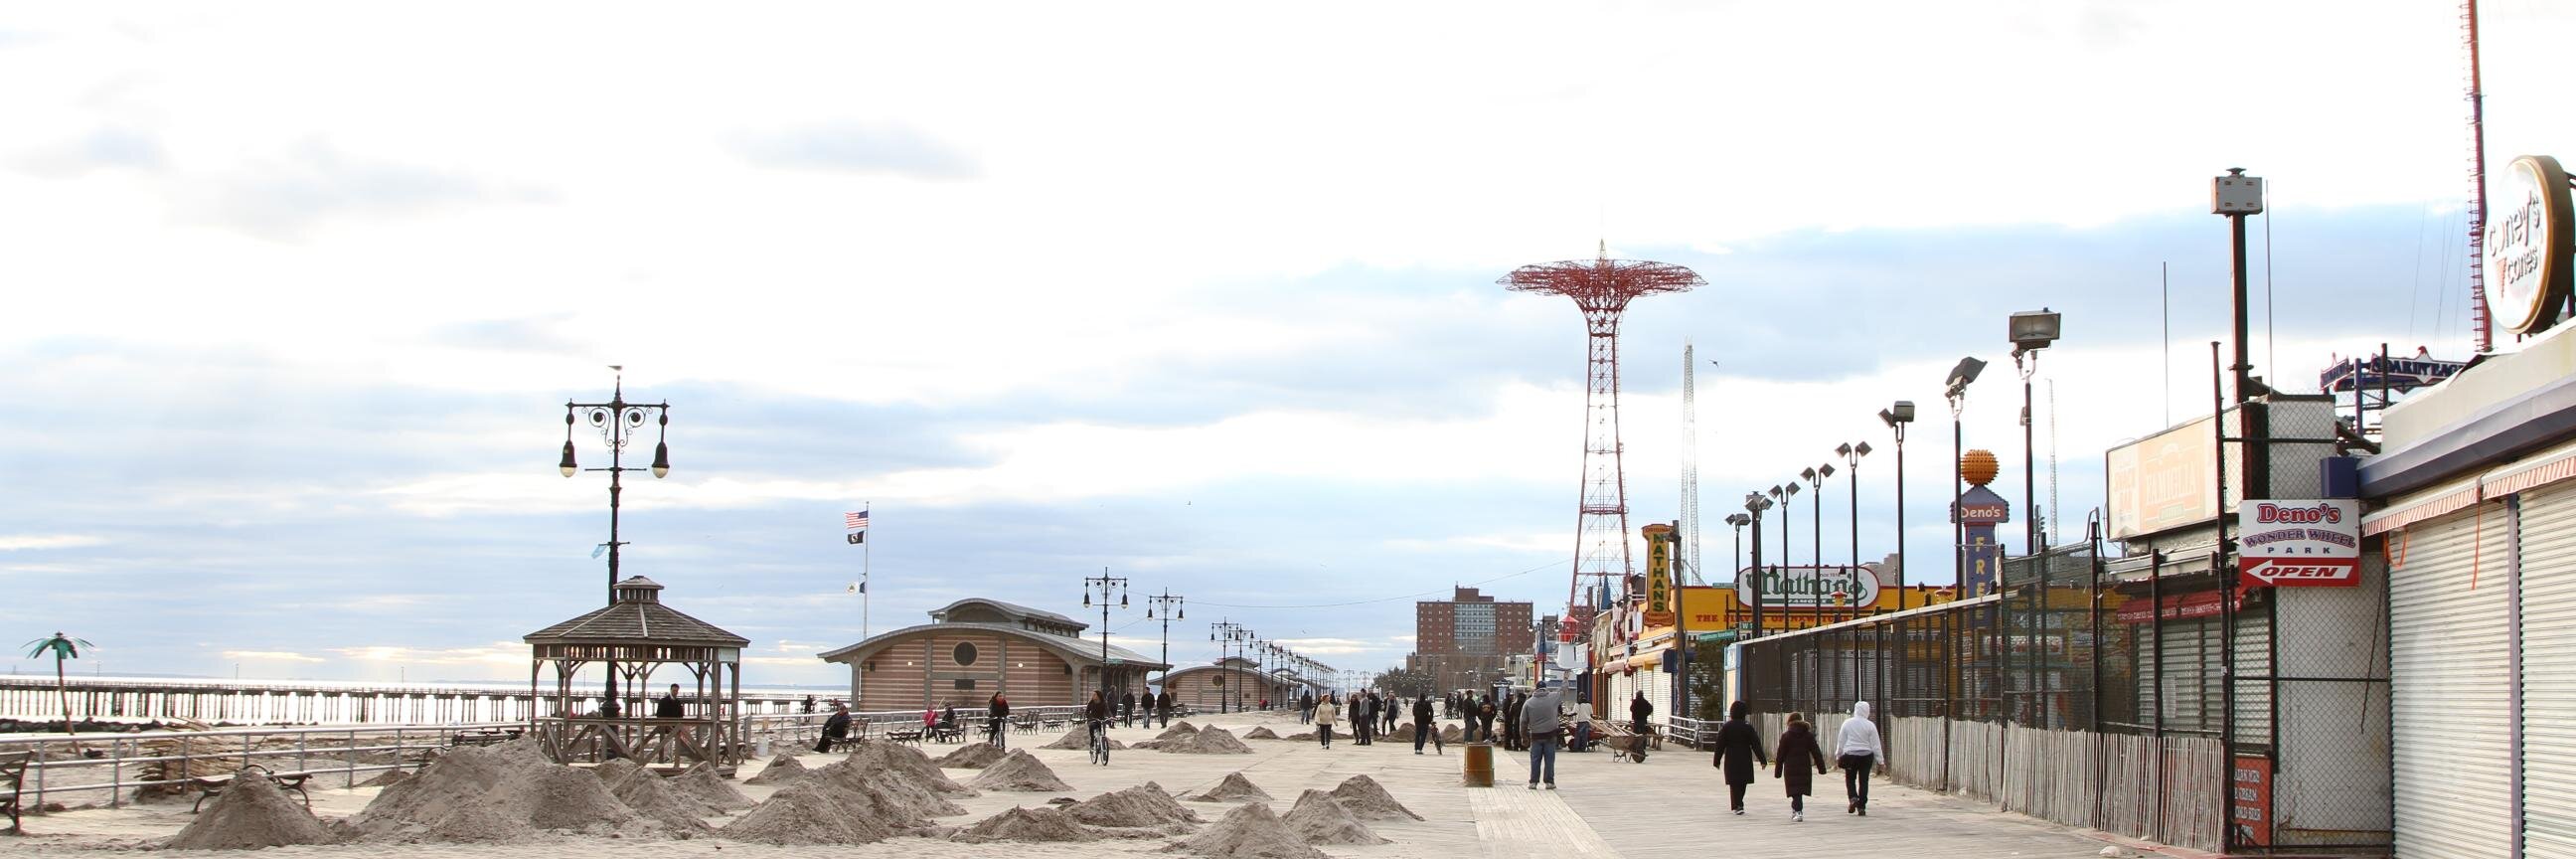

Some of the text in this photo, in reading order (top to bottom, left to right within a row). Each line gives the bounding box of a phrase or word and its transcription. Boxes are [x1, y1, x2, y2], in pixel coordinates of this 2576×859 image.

[2507, 247, 2539, 284] cones
[1961, 506, 2001, 518] Deno's
[2257, 503, 2341, 524] Deno's
[2243, 528, 2356, 549] WONDER WHEEL
[1653, 533, 1665, 612] NATHANS
[2260, 567, 2337, 577] OPEN
[1746, 570, 1868, 601] Nathan's
